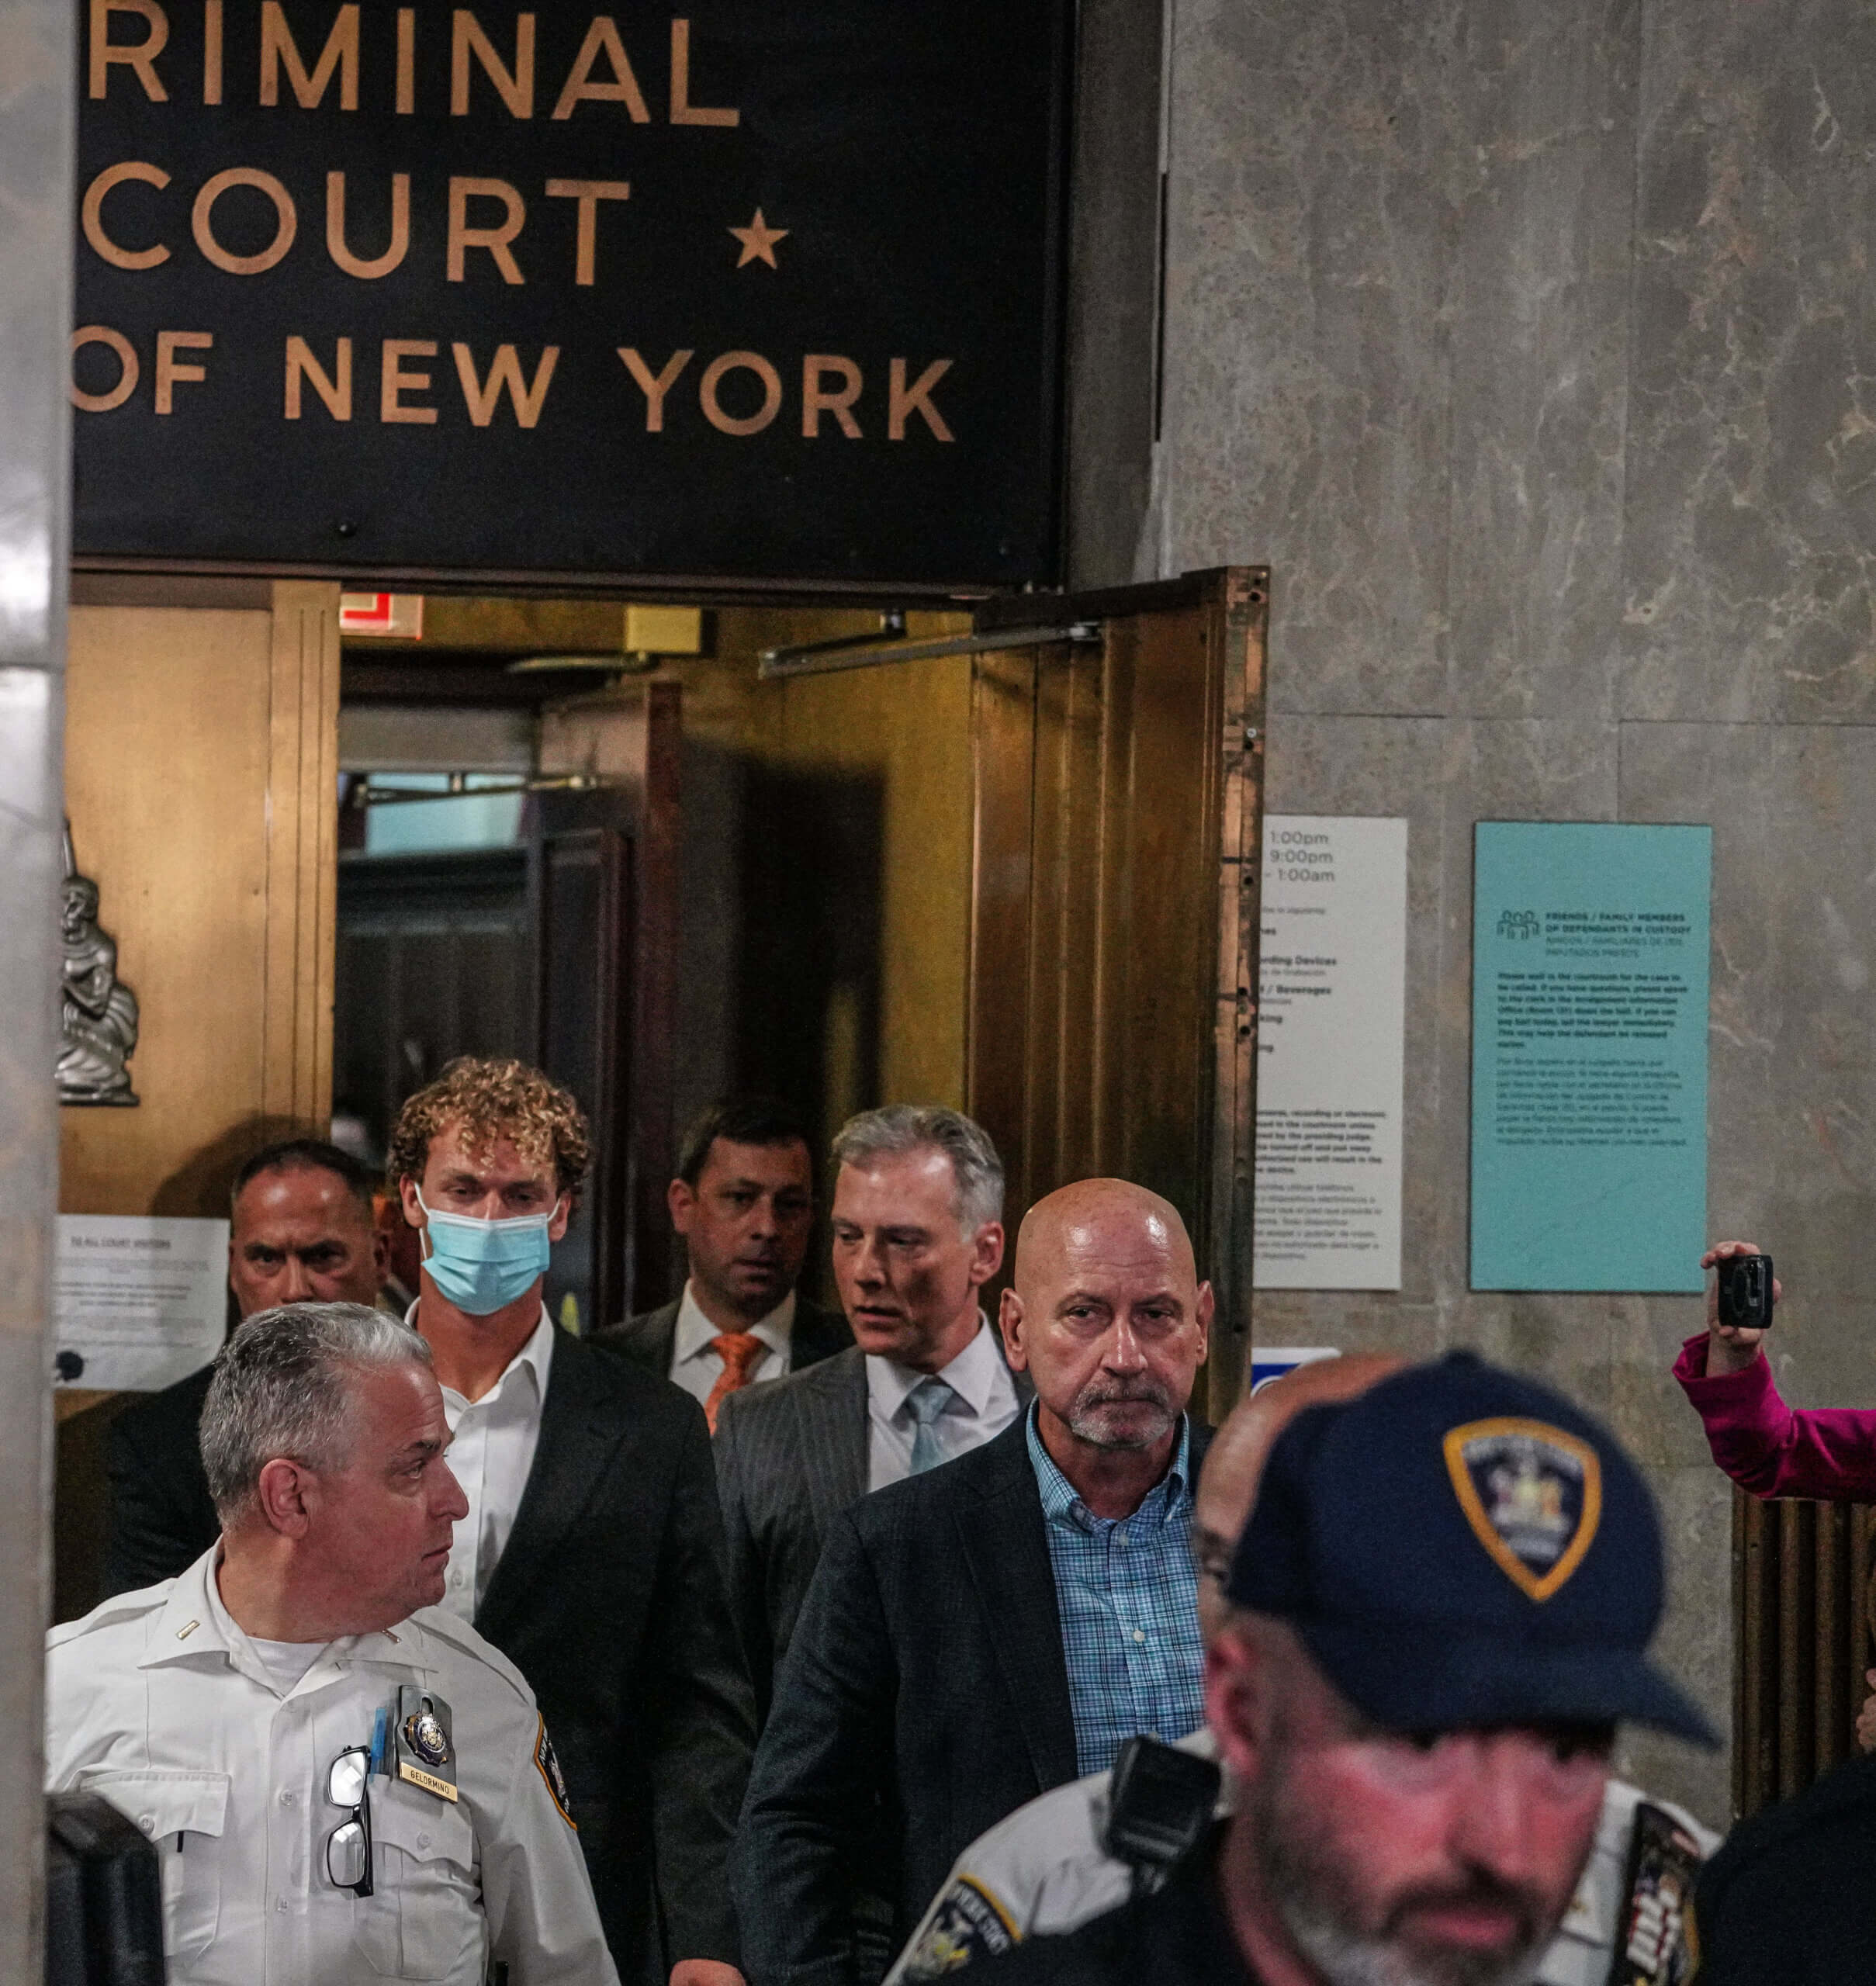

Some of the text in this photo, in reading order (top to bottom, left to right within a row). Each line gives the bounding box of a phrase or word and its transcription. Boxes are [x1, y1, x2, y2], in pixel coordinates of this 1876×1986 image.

[88, 0, 739, 127] RIMINAL
[81, 161, 630, 286] COURT
[70, 325, 956, 443] OF NEW YORK
[1271, 830, 1329, 845] 1:00pm
[1270, 849, 1334, 864] 9:00pm
[1279, 867, 1335, 882] 1:00am
[410, 1770, 449, 1794] GELORMINO
